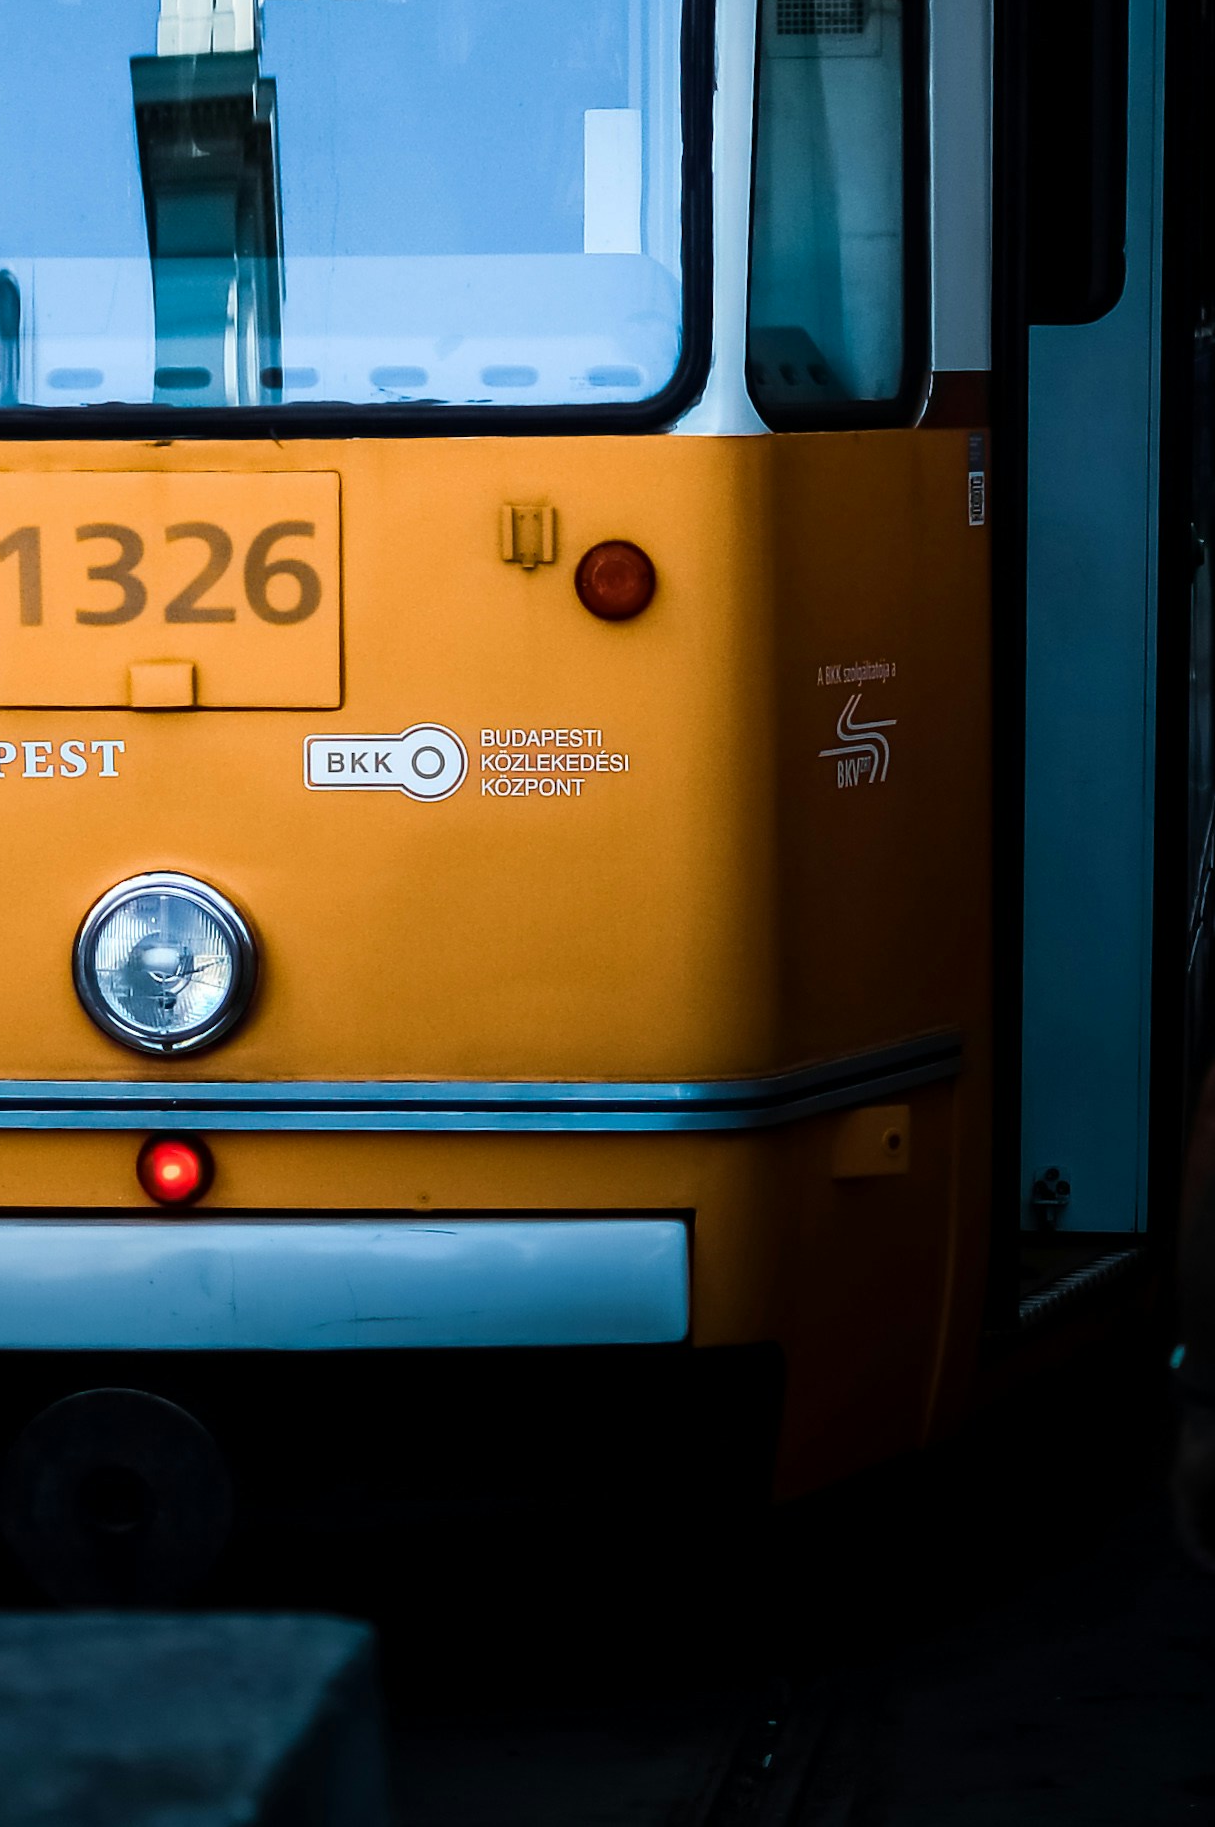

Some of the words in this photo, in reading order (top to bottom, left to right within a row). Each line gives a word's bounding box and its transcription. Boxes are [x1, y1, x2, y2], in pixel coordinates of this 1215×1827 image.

[817, 666, 824, 686] A
[825, 664, 842, 686] BKK
[891, 662, 896, 677] a
[480, 729, 602, 748] BUDAPESTI
[327, 751, 394, 774] BKK
[480, 749, 630, 771] KÖZLEKEDÉSI
[480, 775, 585, 797] KÖZPONT
